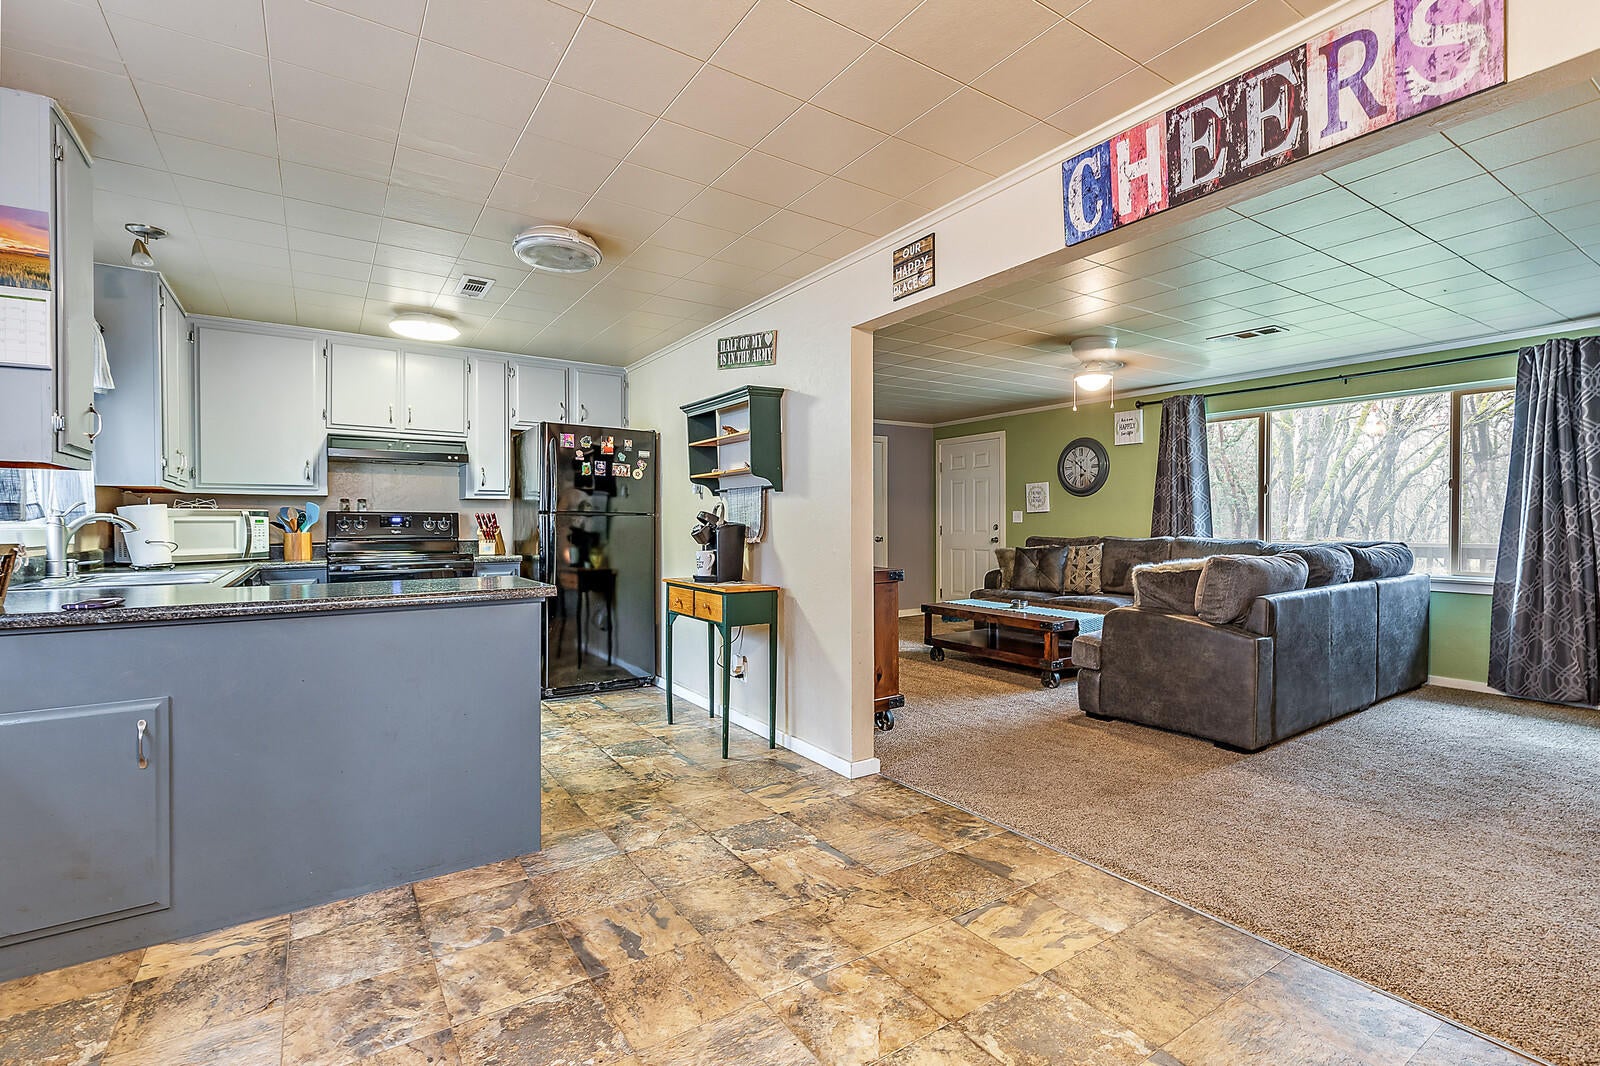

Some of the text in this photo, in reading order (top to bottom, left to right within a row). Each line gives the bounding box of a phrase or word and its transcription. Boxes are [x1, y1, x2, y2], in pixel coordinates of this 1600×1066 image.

[1067, 0, 1488, 233] CHEERS
[902, 243, 921, 258] OUR
[895, 255, 929, 280] HAPPY
[893, 275, 919, 296] PLACE
[720, 334, 763, 352] HALF OF MY
[720, 348, 773, 366] IS IN THE ARMY
